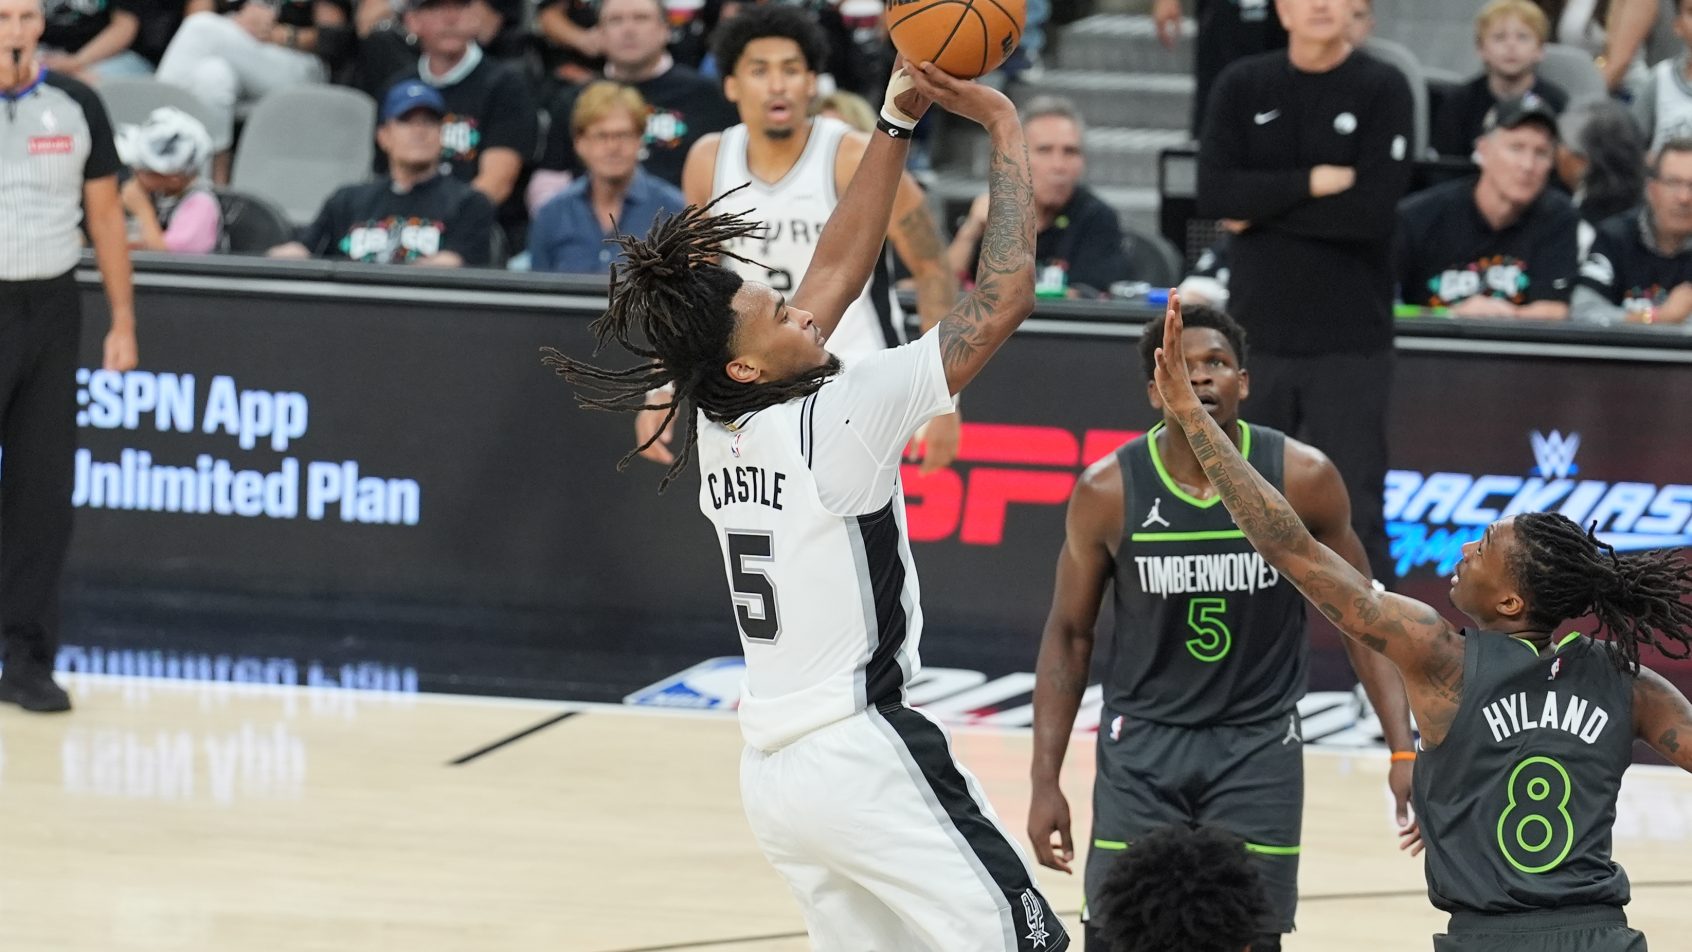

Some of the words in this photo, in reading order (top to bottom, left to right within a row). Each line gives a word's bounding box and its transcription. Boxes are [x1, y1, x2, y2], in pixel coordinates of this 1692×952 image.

[202, 375, 309, 452] App
[306, 460, 421, 526] Plan
[707, 466, 786, 511] CASTLE
[724, 527, 783, 646] 5
[1186, 597, 1232, 662] 5
[1482, 691, 1609, 744] HYLAND
[1497, 756, 1574, 873] 8
